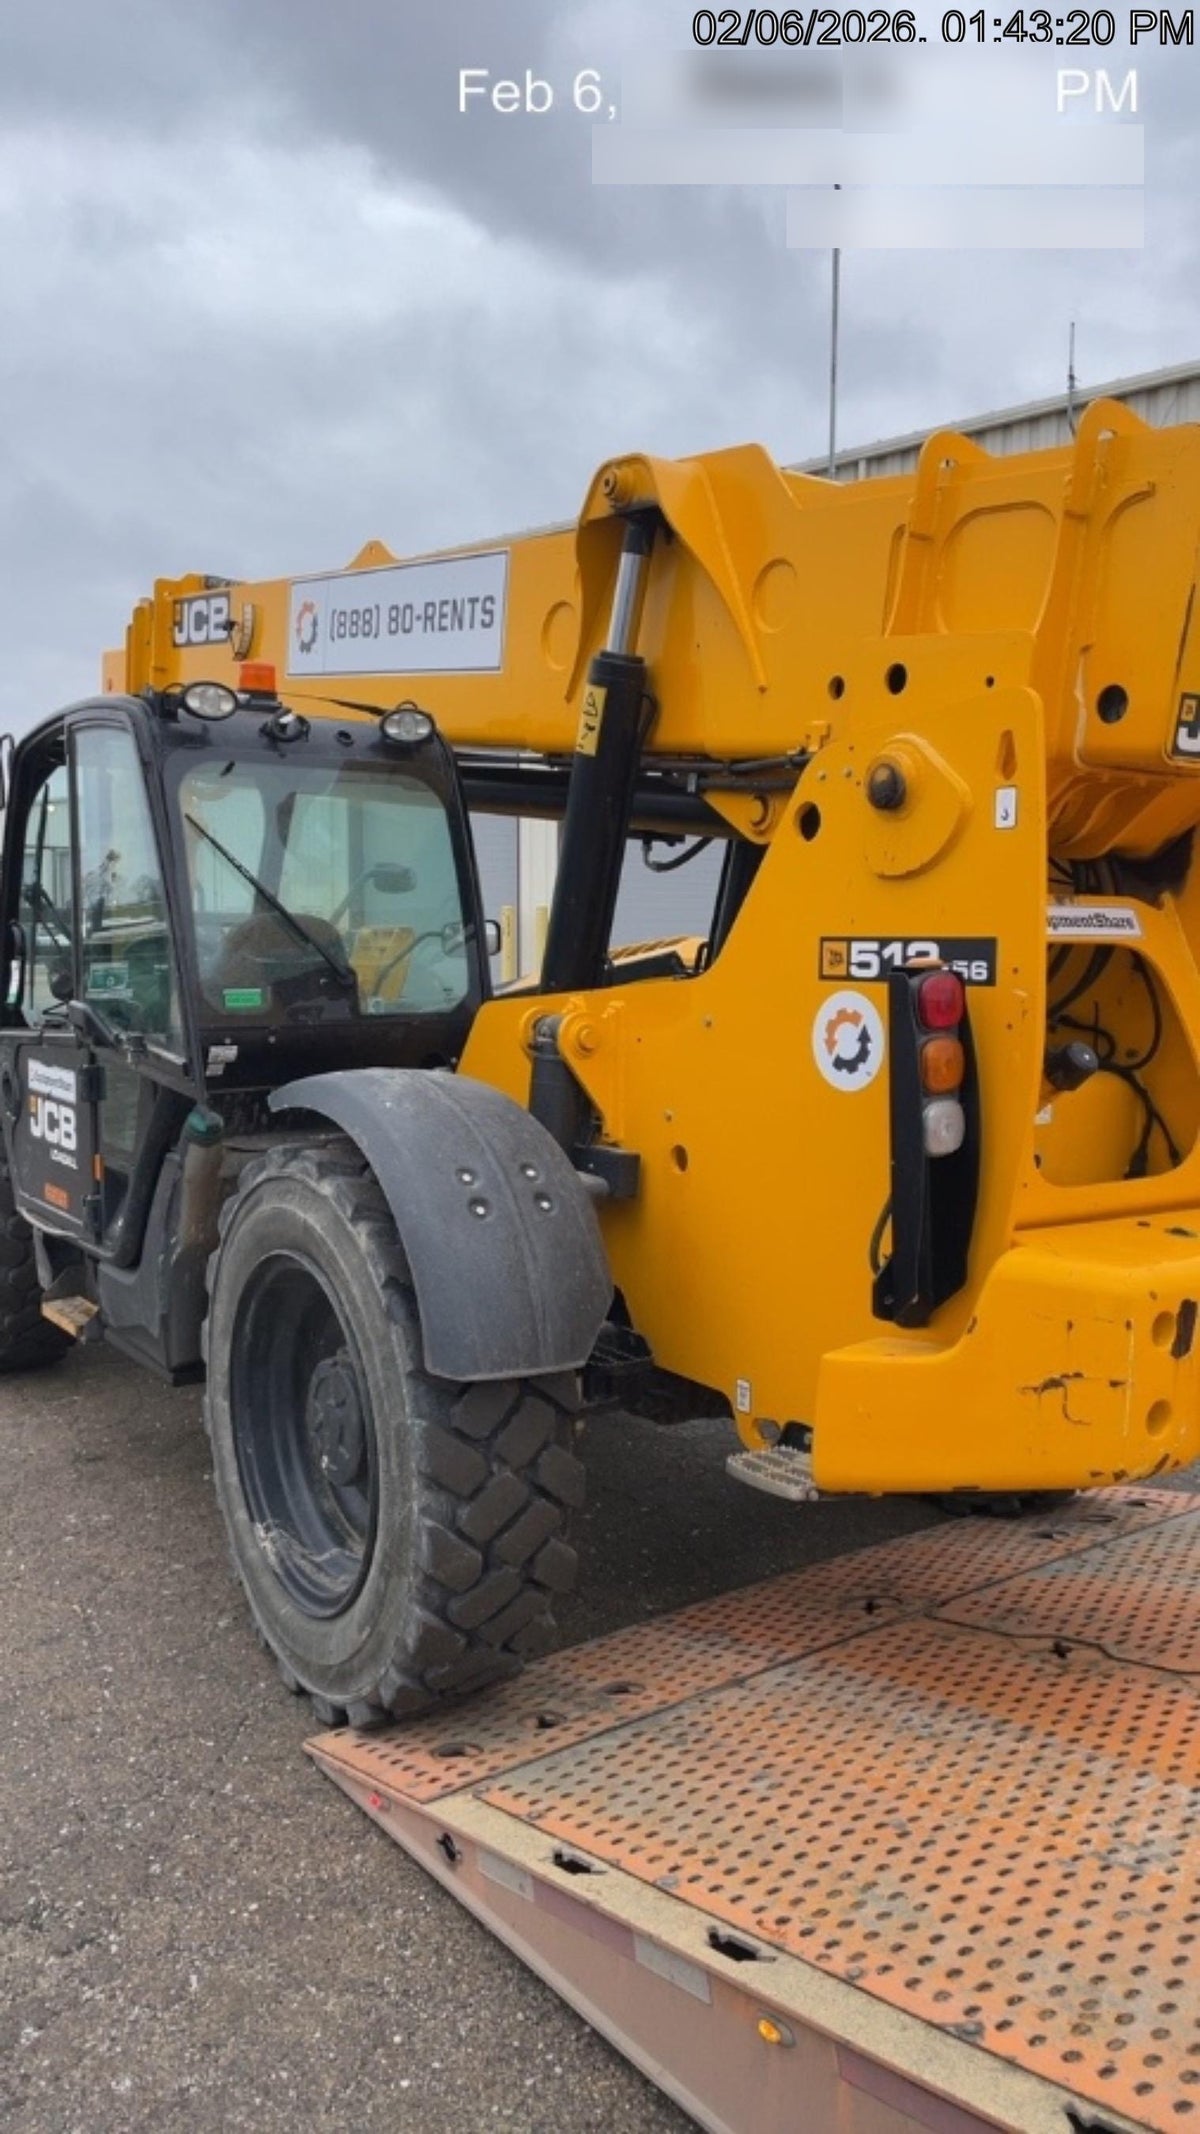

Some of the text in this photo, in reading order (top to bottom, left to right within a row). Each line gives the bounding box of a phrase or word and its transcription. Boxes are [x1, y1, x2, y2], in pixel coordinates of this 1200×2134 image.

[174, 596, 229, 645] JCB
[329, 594, 496, 643] (888) 80-RENTS
[29, 1095, 77, 1151] JCB
